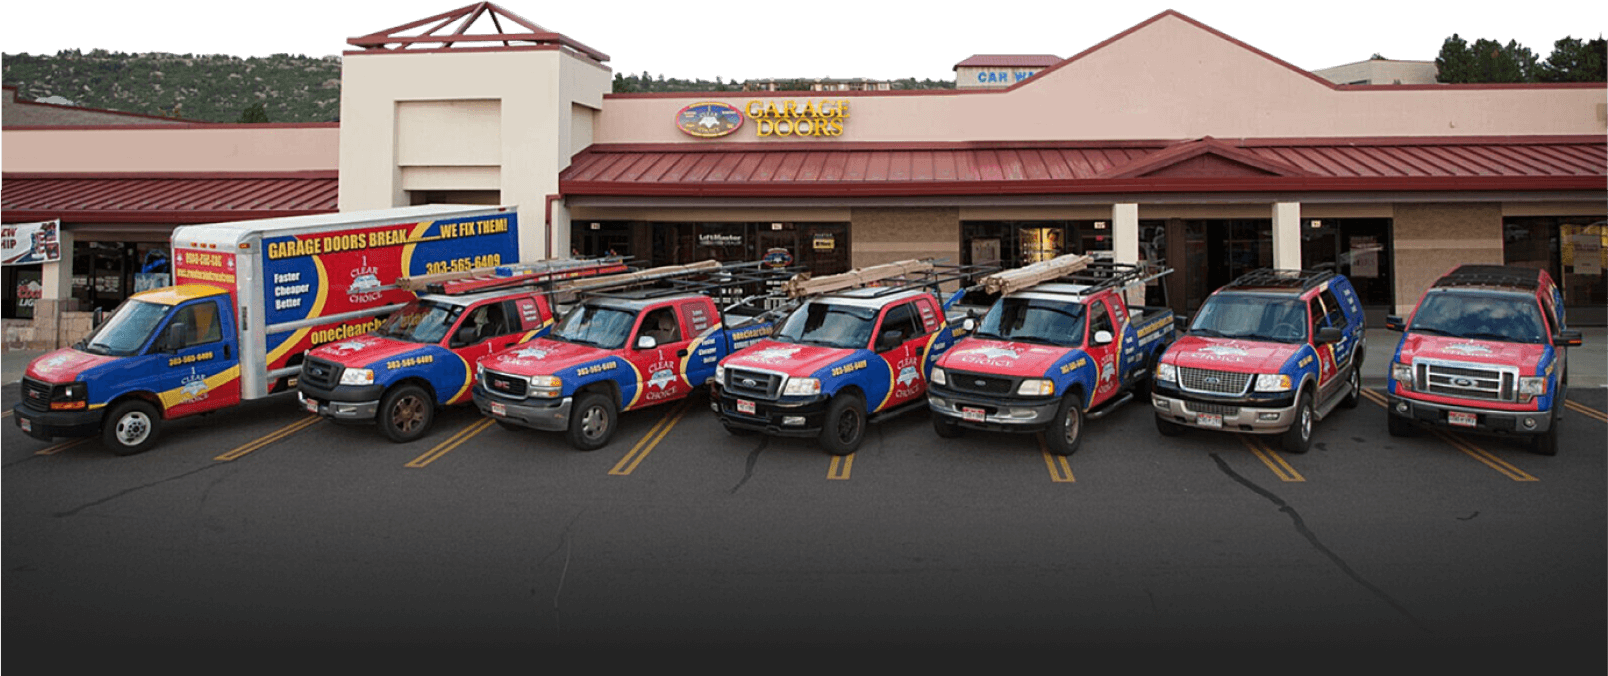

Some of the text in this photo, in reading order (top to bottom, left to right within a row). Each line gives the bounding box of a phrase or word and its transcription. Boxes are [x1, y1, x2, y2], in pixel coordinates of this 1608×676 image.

[978, 72, 1008, 82] CAR
[745, 100, 850, 119] GARAGE
[756, 118, 844, 138] DOORS
[268, 238, 322, 260] GARAGE
[323, 233, 366, 253] DOORS
[460, 222, 476, 236] FIX
[476, 218, 508, 234] THEM!
[426, 253, 500, 276] 303-565-6409
[274, 272, 300, 284] Faster
[350, 266, 379, 278] CLEAR
[274, 284, 310, 297] Cheaper
[275, 298, 302, 310] Better
[349, 292, 382, 303] CHOICE
[658, 349, 664, 360] 1
[648, 360, 674, 374] CLEAR
[646, 386, 677, 400] CHOICE
